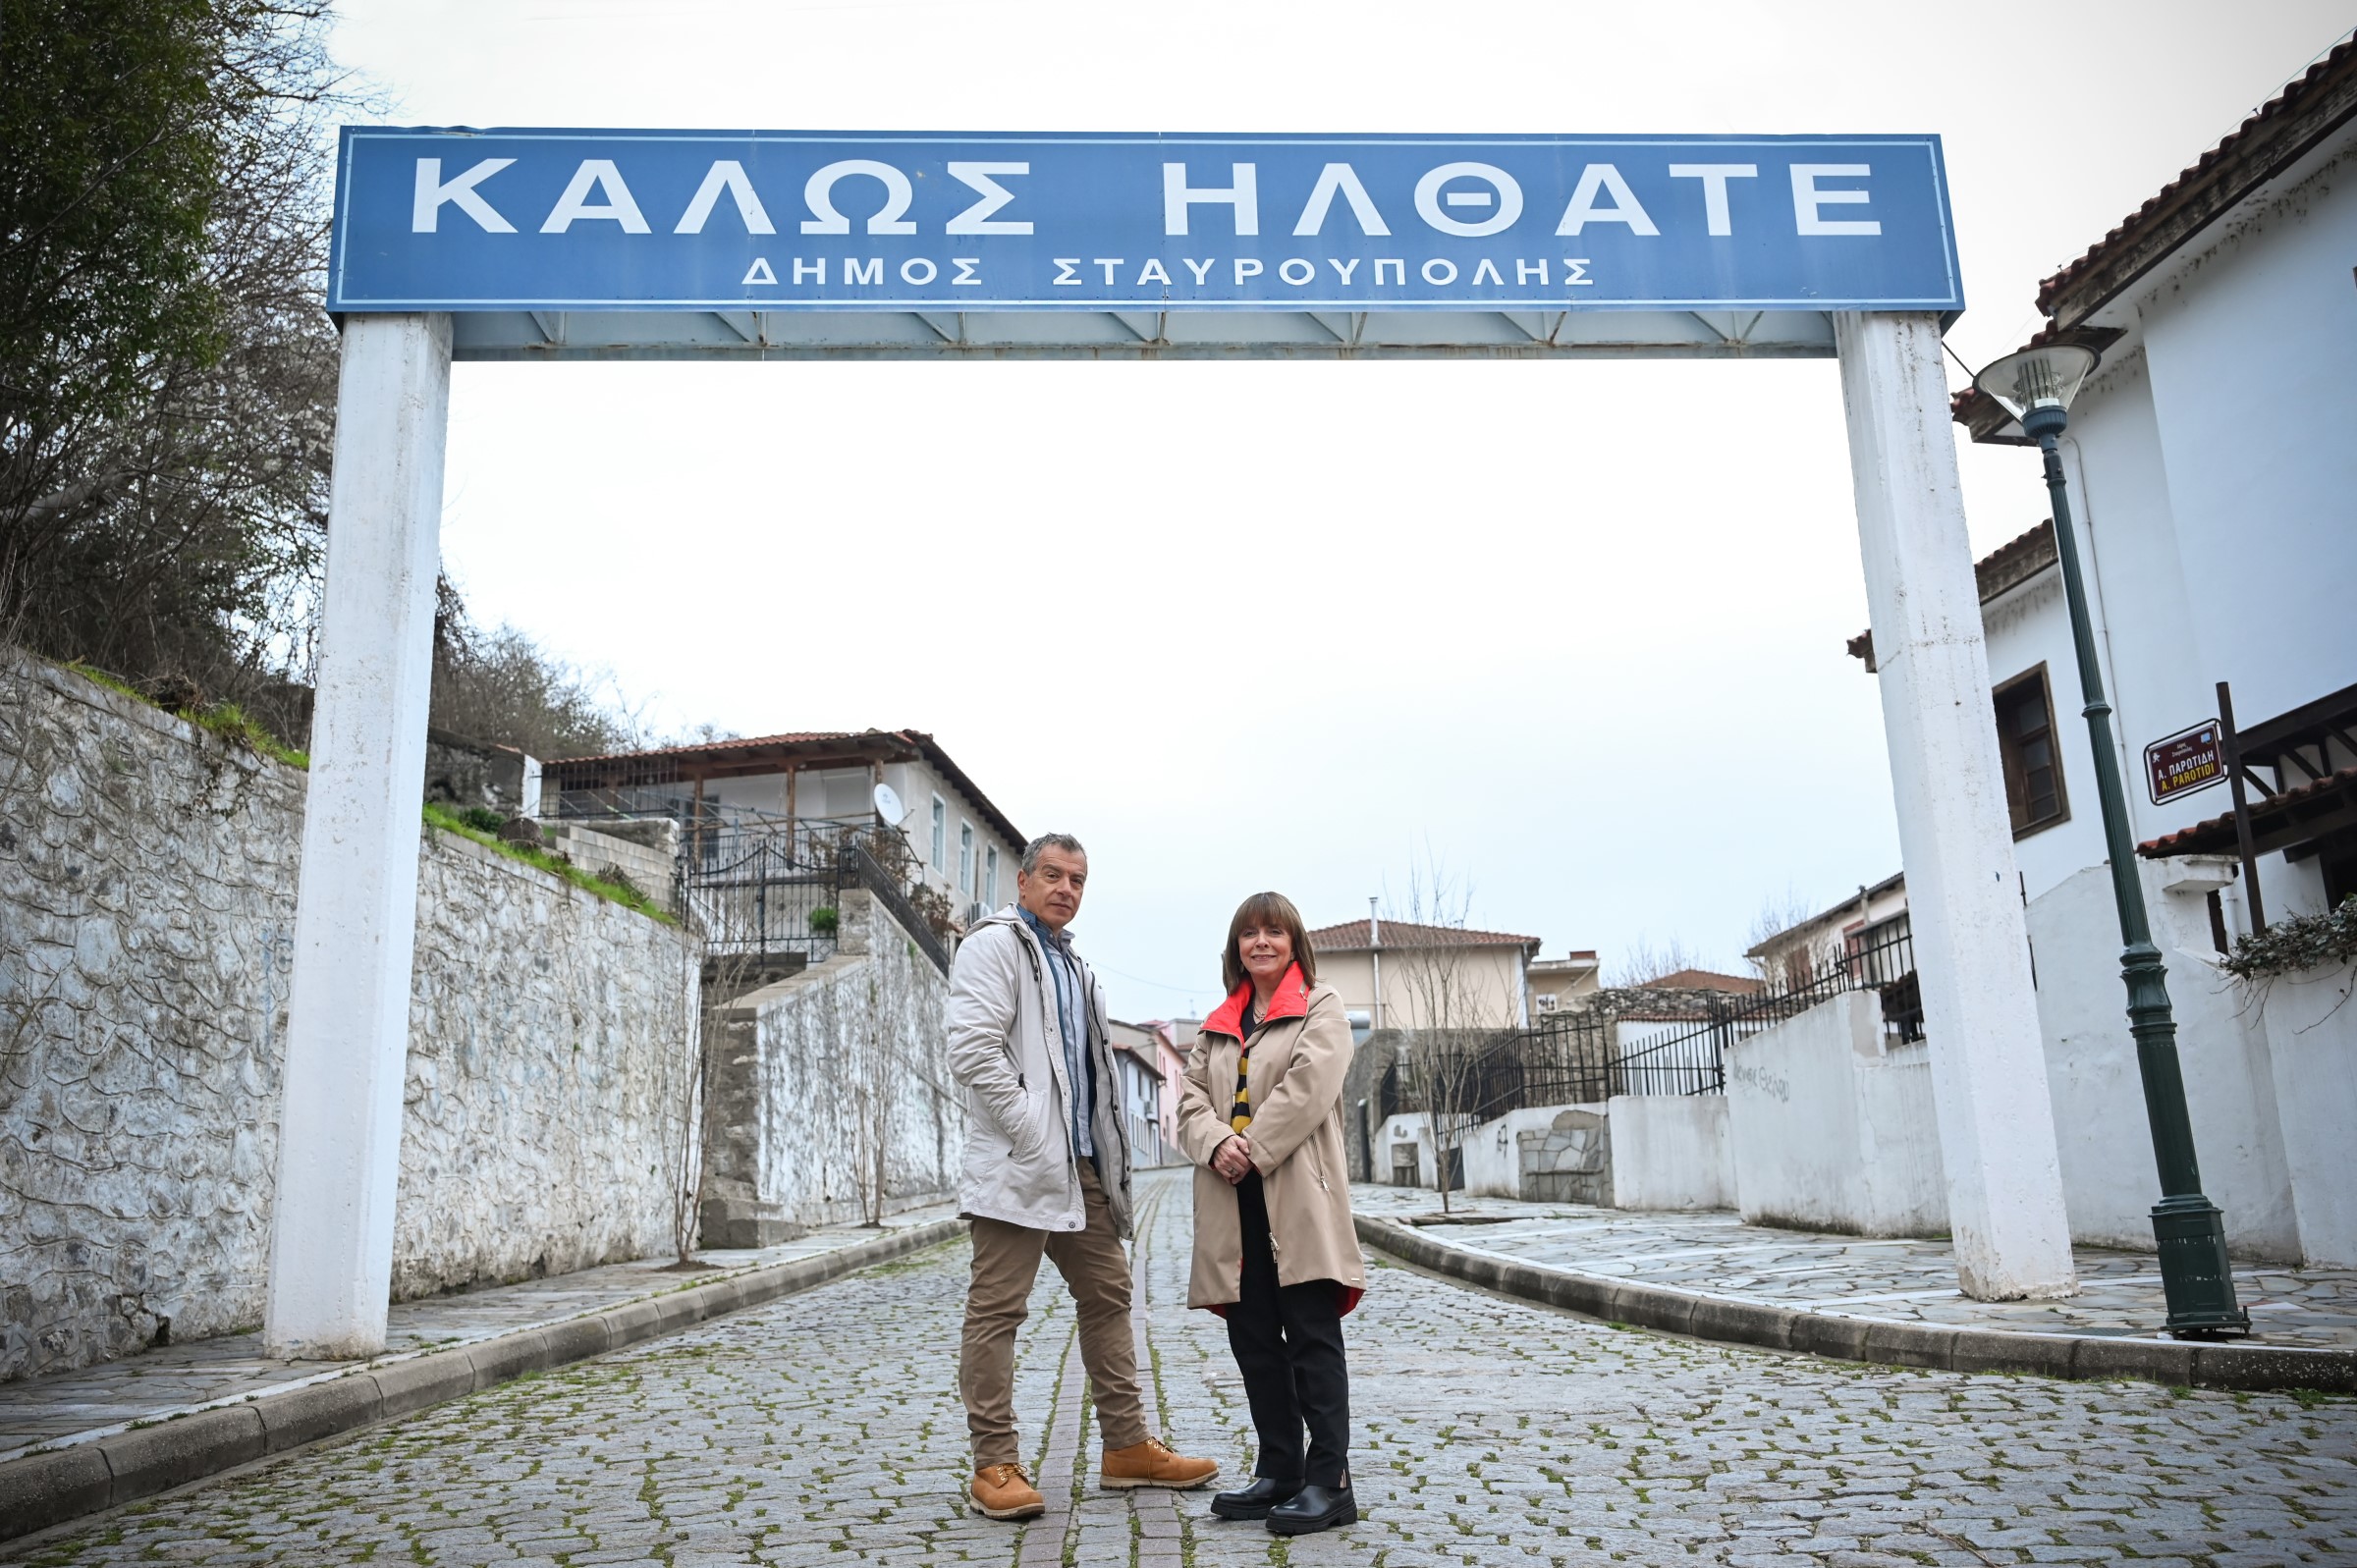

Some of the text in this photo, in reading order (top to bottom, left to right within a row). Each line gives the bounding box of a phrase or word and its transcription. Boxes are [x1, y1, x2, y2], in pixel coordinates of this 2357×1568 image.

[411, 157, 1883, 238] ΚΑΛΩΣ ΗΛΘΑΤΕ
[740, 256, 1595, 287] ΔΗΜΟΣ ΣΤΑΥΡΟΥΠΟΛΗΣ
[2168, 749, 2215, 777] ΠΑΡΩΤΙΔΗ
[2172, 762, 2215, 787] PAROTIDI
